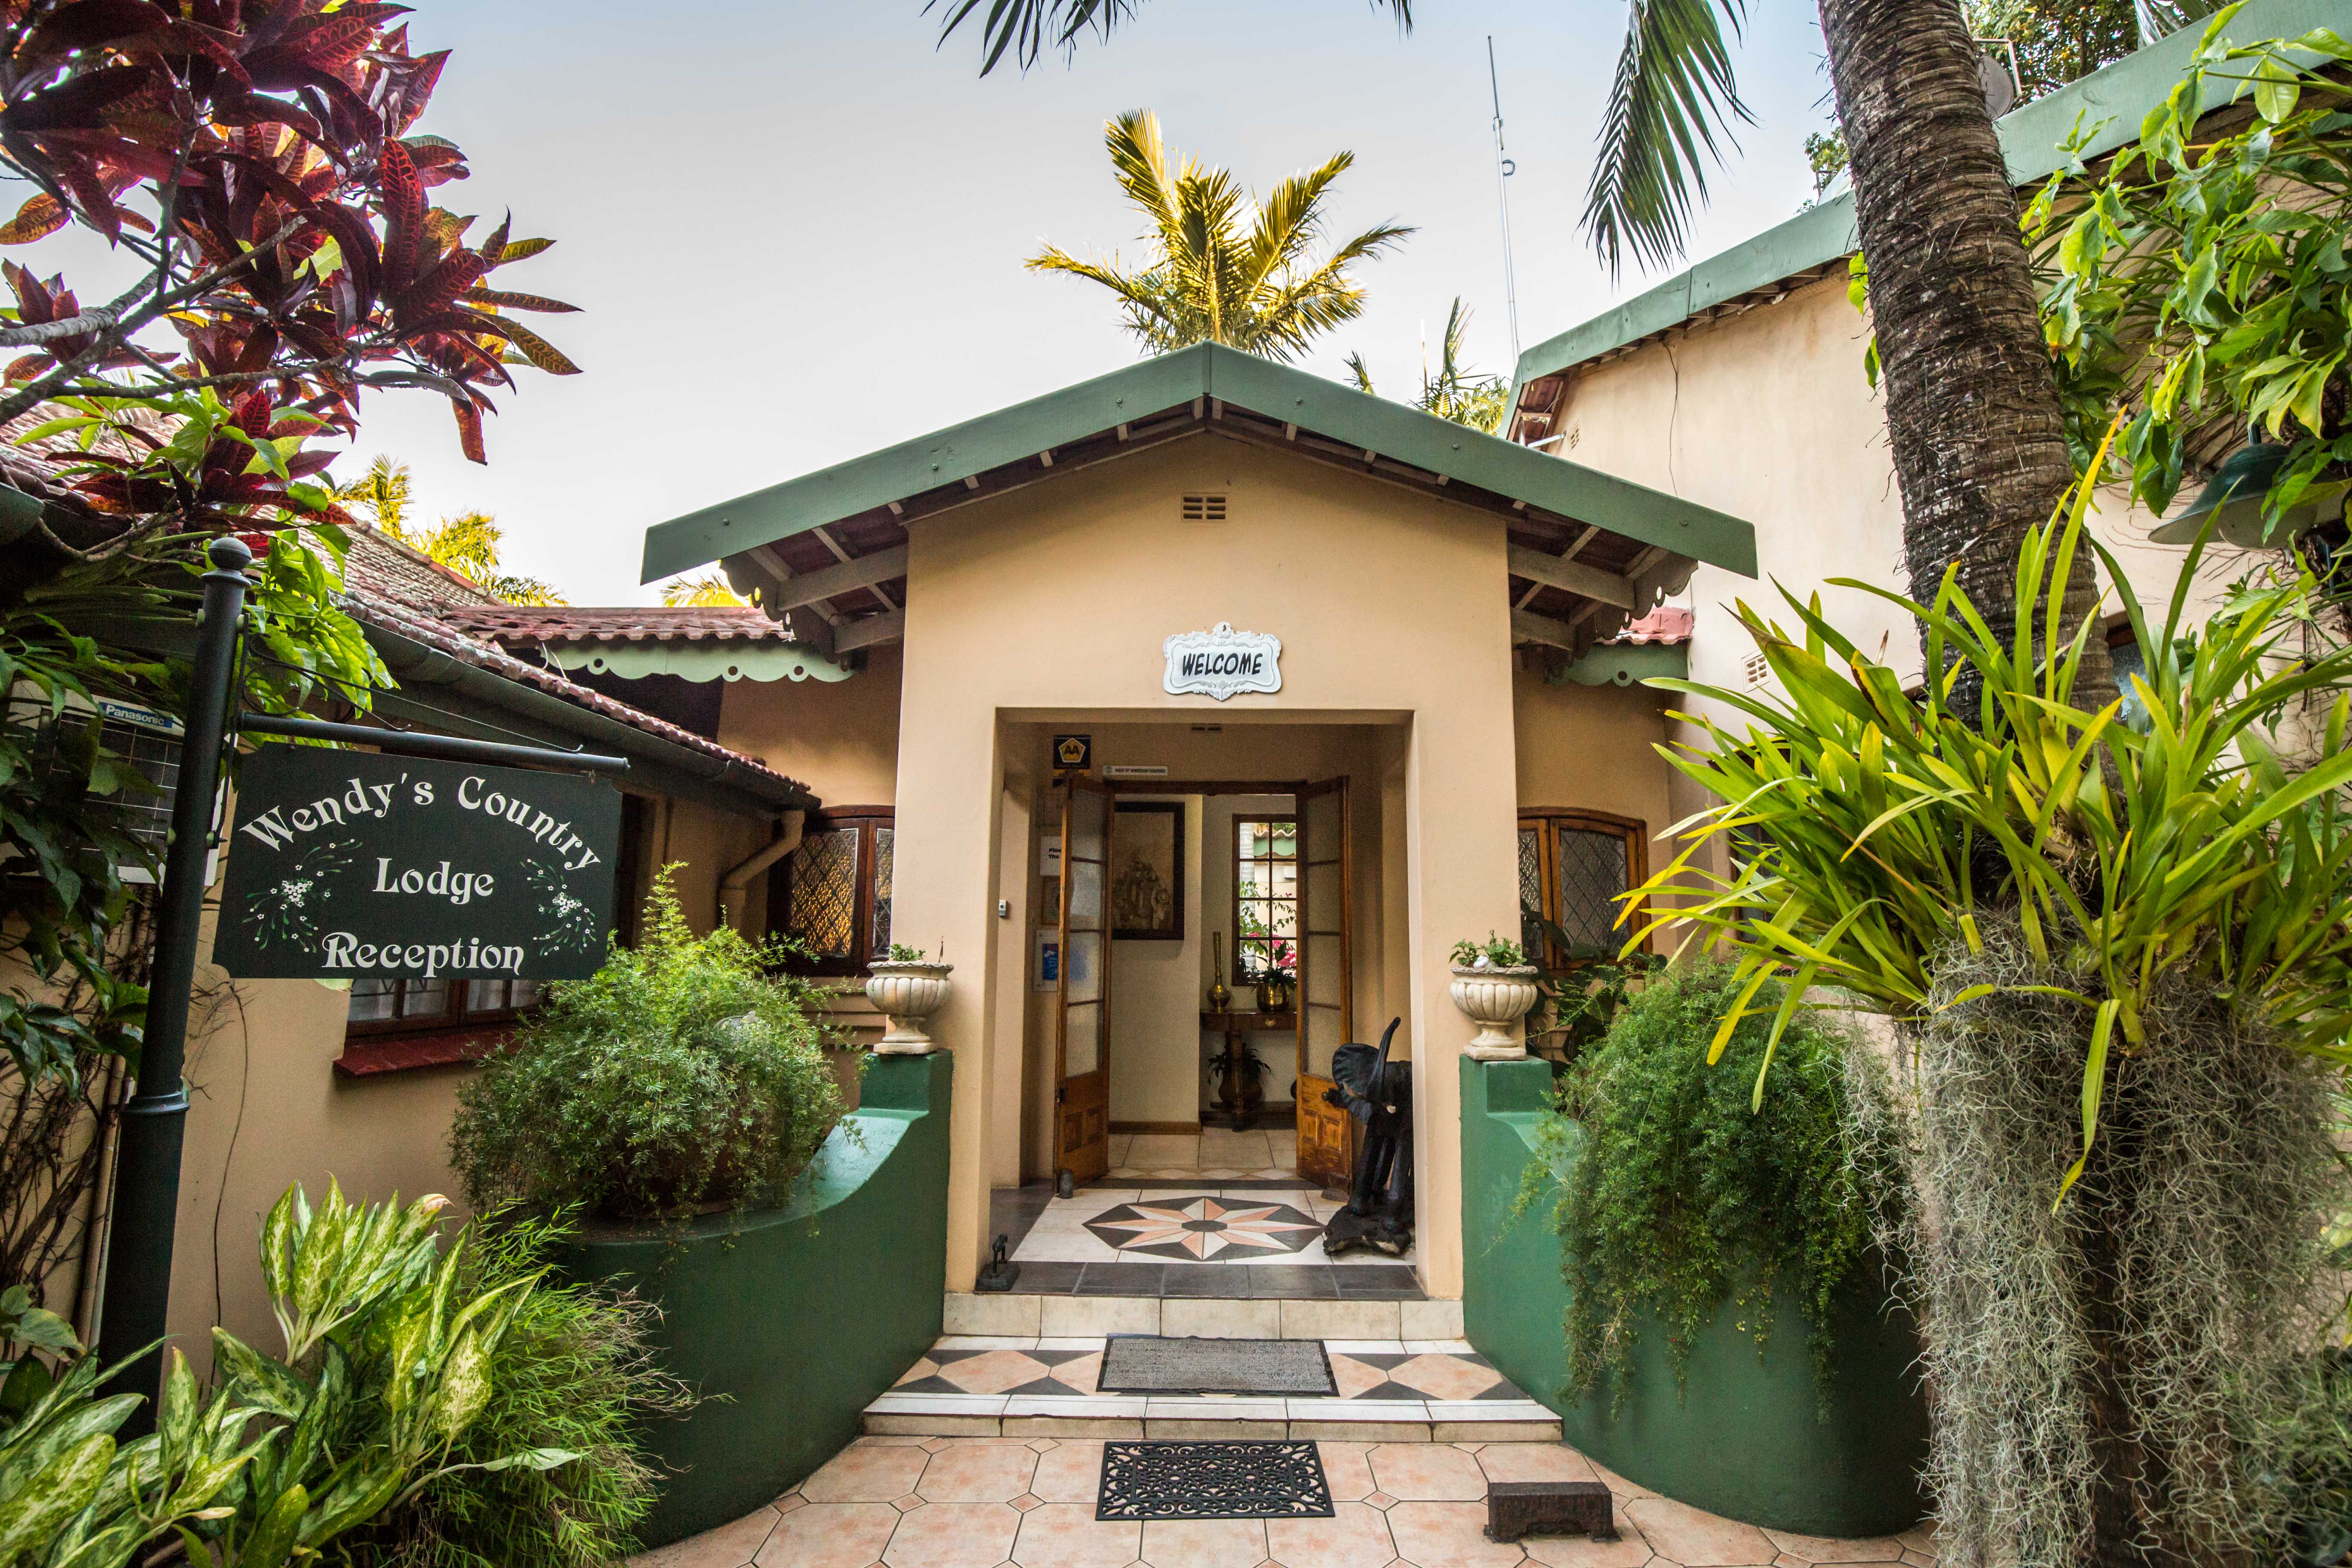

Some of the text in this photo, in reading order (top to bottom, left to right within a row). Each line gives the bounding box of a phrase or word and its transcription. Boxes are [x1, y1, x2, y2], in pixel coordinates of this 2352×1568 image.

[1182, 652, 1263, 676] WELCOME
[106, 704, 165, 725] Panasonic
[1064, 745, 1080, 755] AA
[239, 772, 601, 870] Wendy's Country
[373, 858, 493, 904] Lodge
[322, 932, 524, 977] Reception
